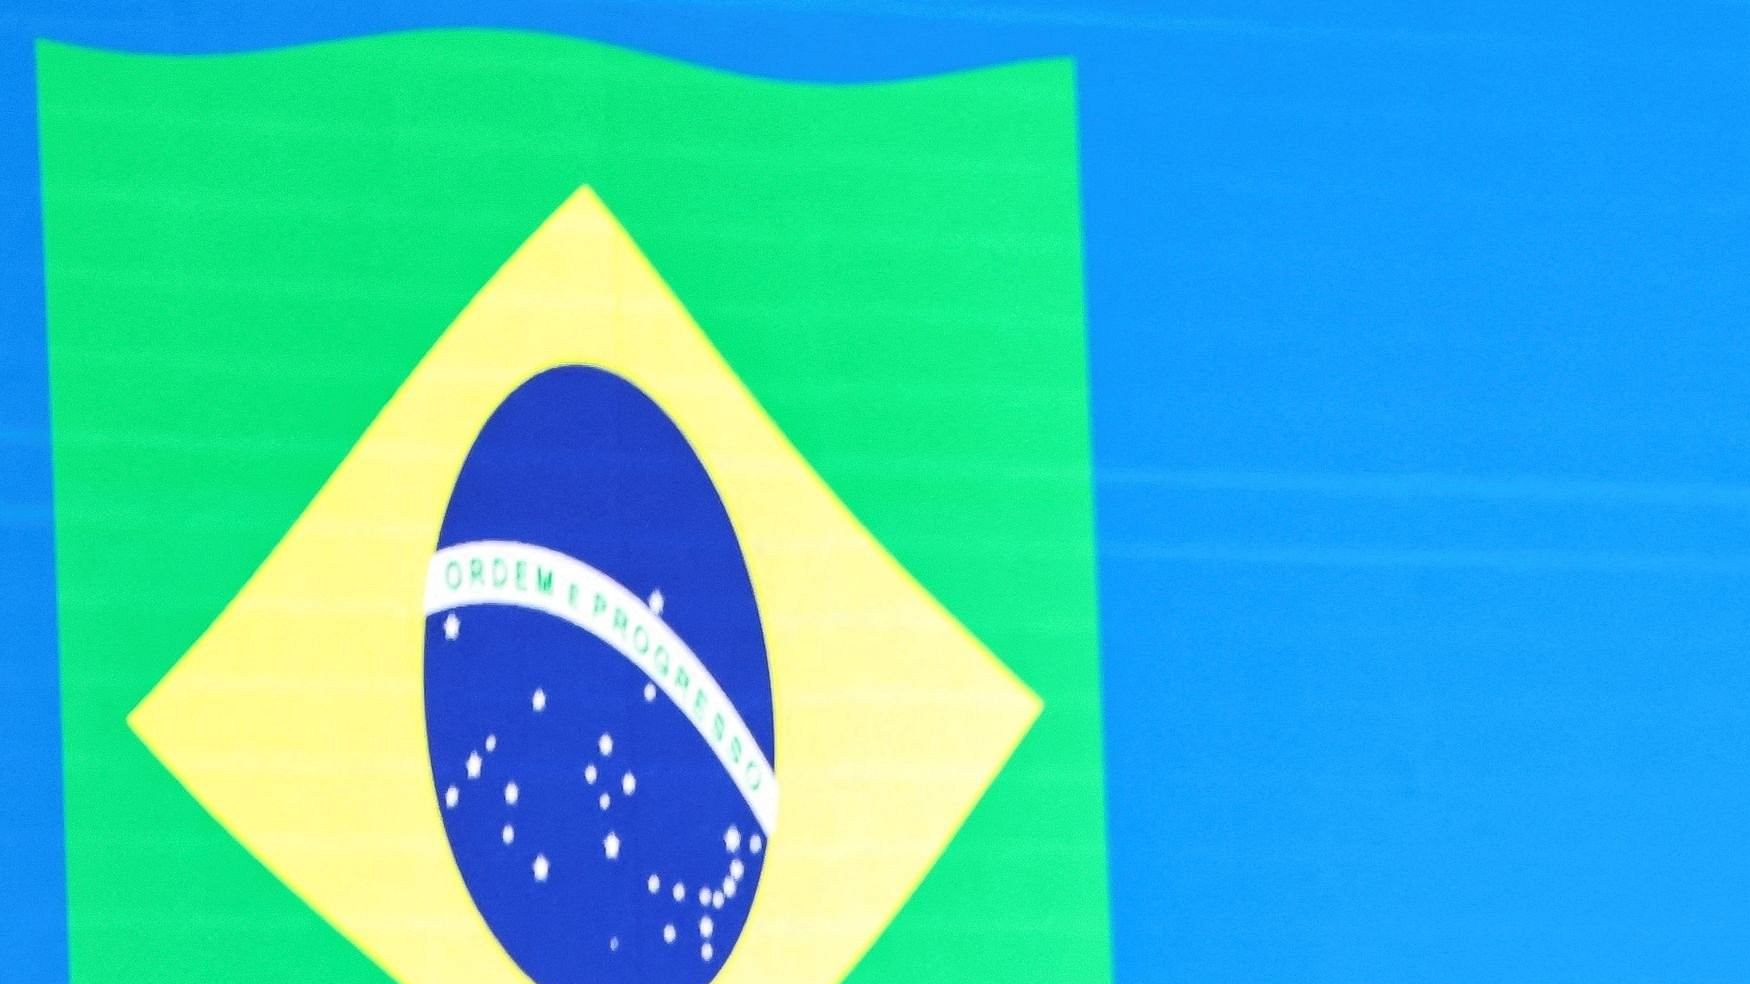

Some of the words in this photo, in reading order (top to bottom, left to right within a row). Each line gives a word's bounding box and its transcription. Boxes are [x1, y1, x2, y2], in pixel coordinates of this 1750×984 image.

[445, 558, 554, 593] ORDEM
[567, 583, 580, 609] E
[592, 593, 762, 791] PROGRESSO
